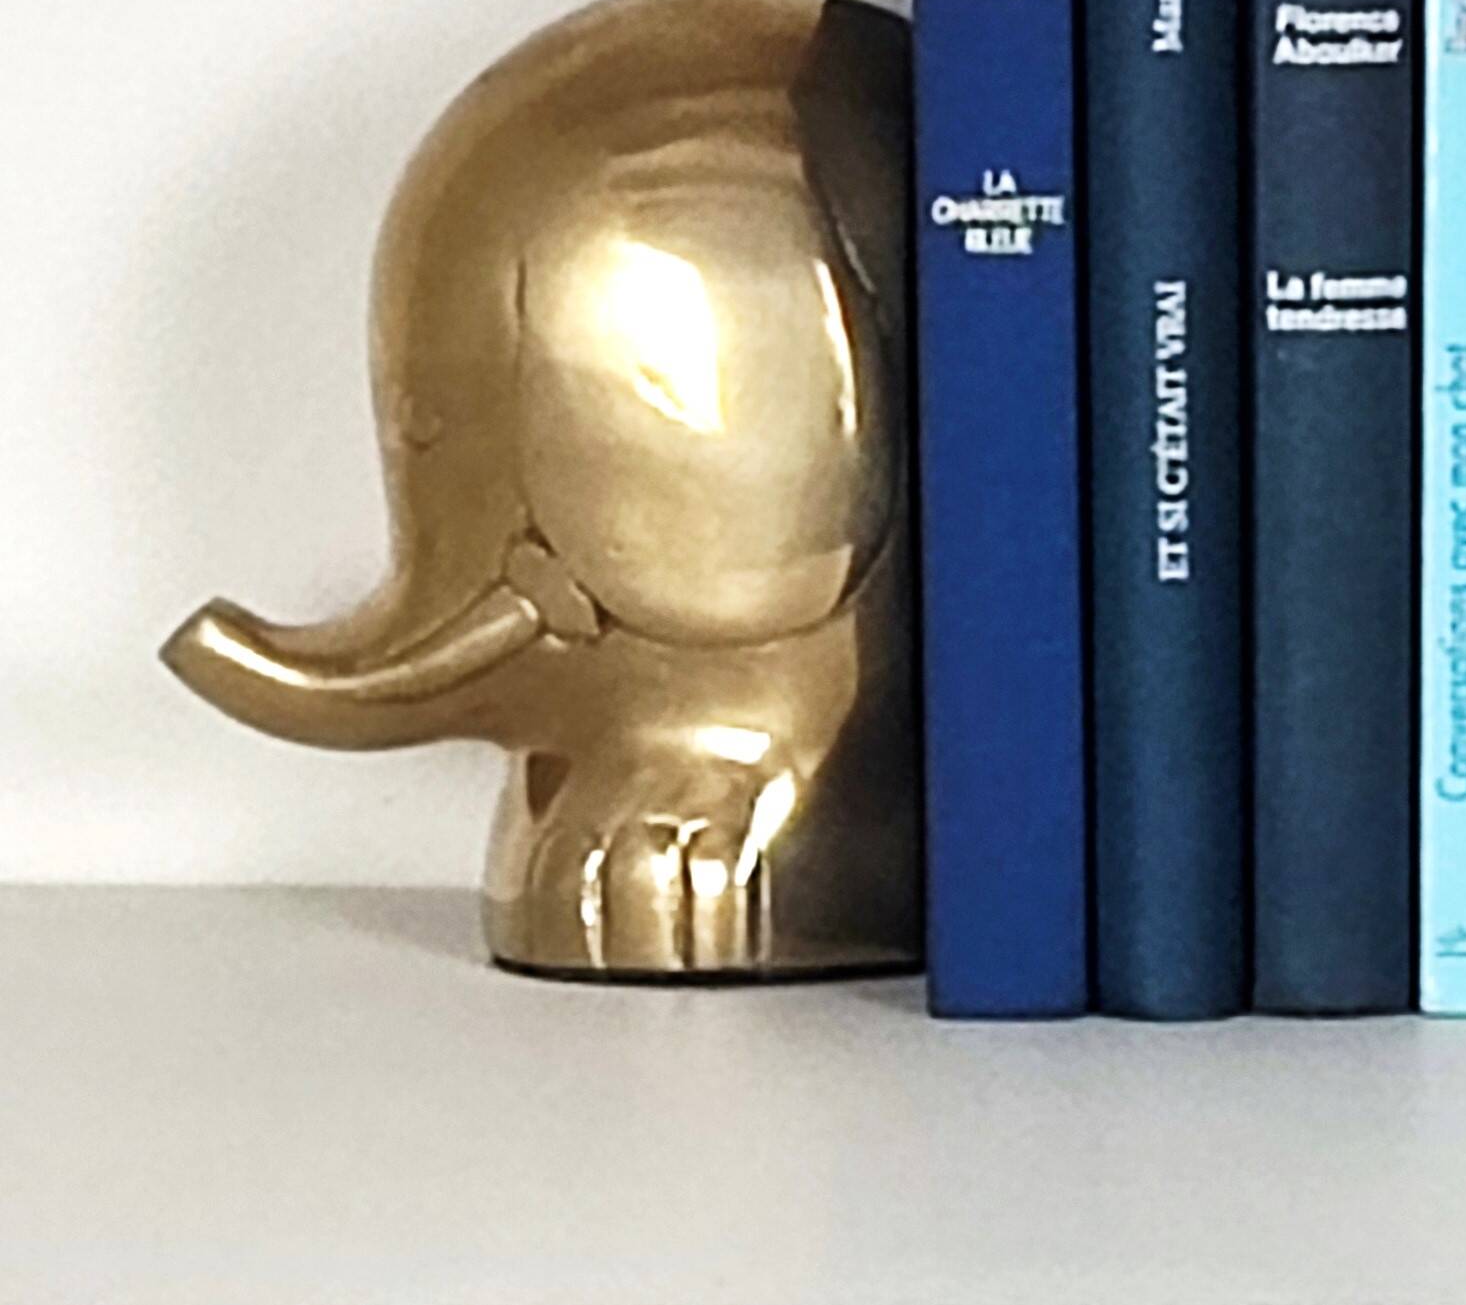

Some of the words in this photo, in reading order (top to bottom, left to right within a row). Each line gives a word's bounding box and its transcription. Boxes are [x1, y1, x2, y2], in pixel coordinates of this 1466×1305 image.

[1275, 3, 1400, 33] Florence
[983, 169, 1017, 196] LA
[1266, 270, 1305, 301] La
[1310, 271, 1408, 301] femme
[1153, 279, 1187, 361] VRAI
[1155, 499, 1189, 533] SI
[1156, 536, 1190, 583] ET
